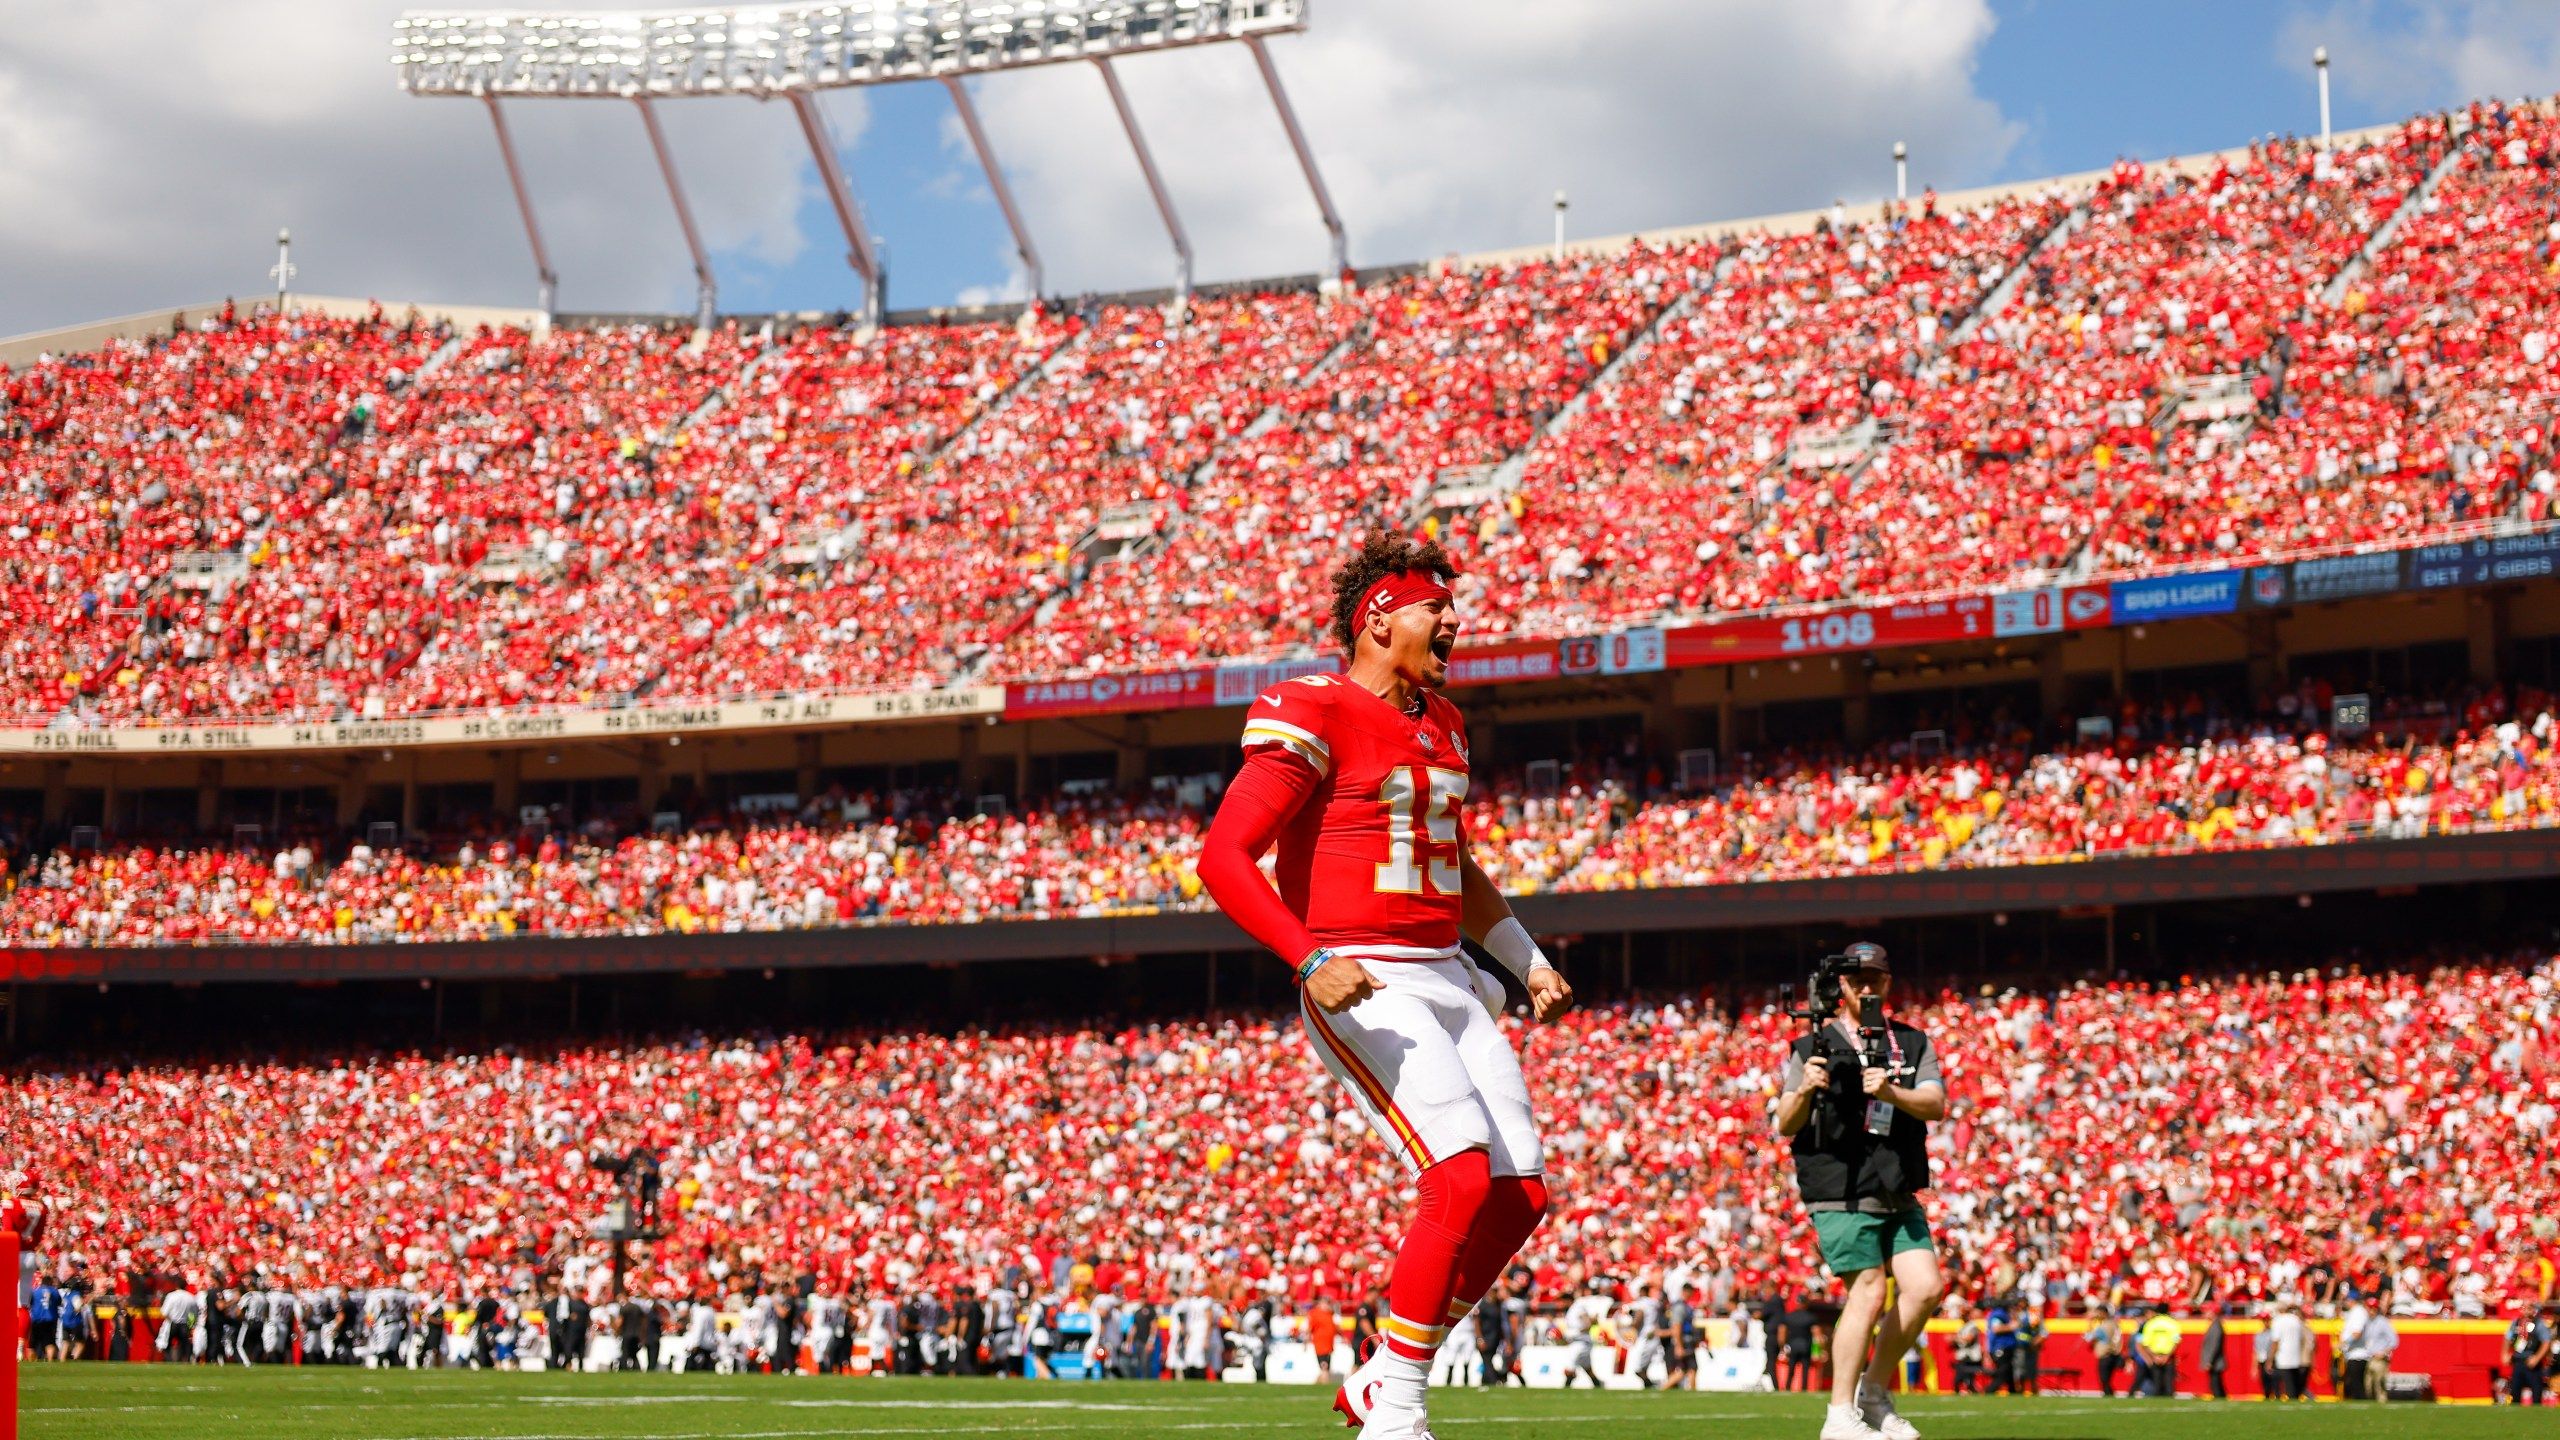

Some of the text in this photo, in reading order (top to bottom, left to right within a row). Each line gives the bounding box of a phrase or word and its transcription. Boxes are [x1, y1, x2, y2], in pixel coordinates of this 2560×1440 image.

[2422, 556, 2553, 587] DET J GIBBS
[2124, 583, 2229, 610] BUD LIGHT
[1782, 612, 1875, 652] 1:08
[1124, 672, 1200, 696] FIRST
[1374, 766, 1469, 895] 15
